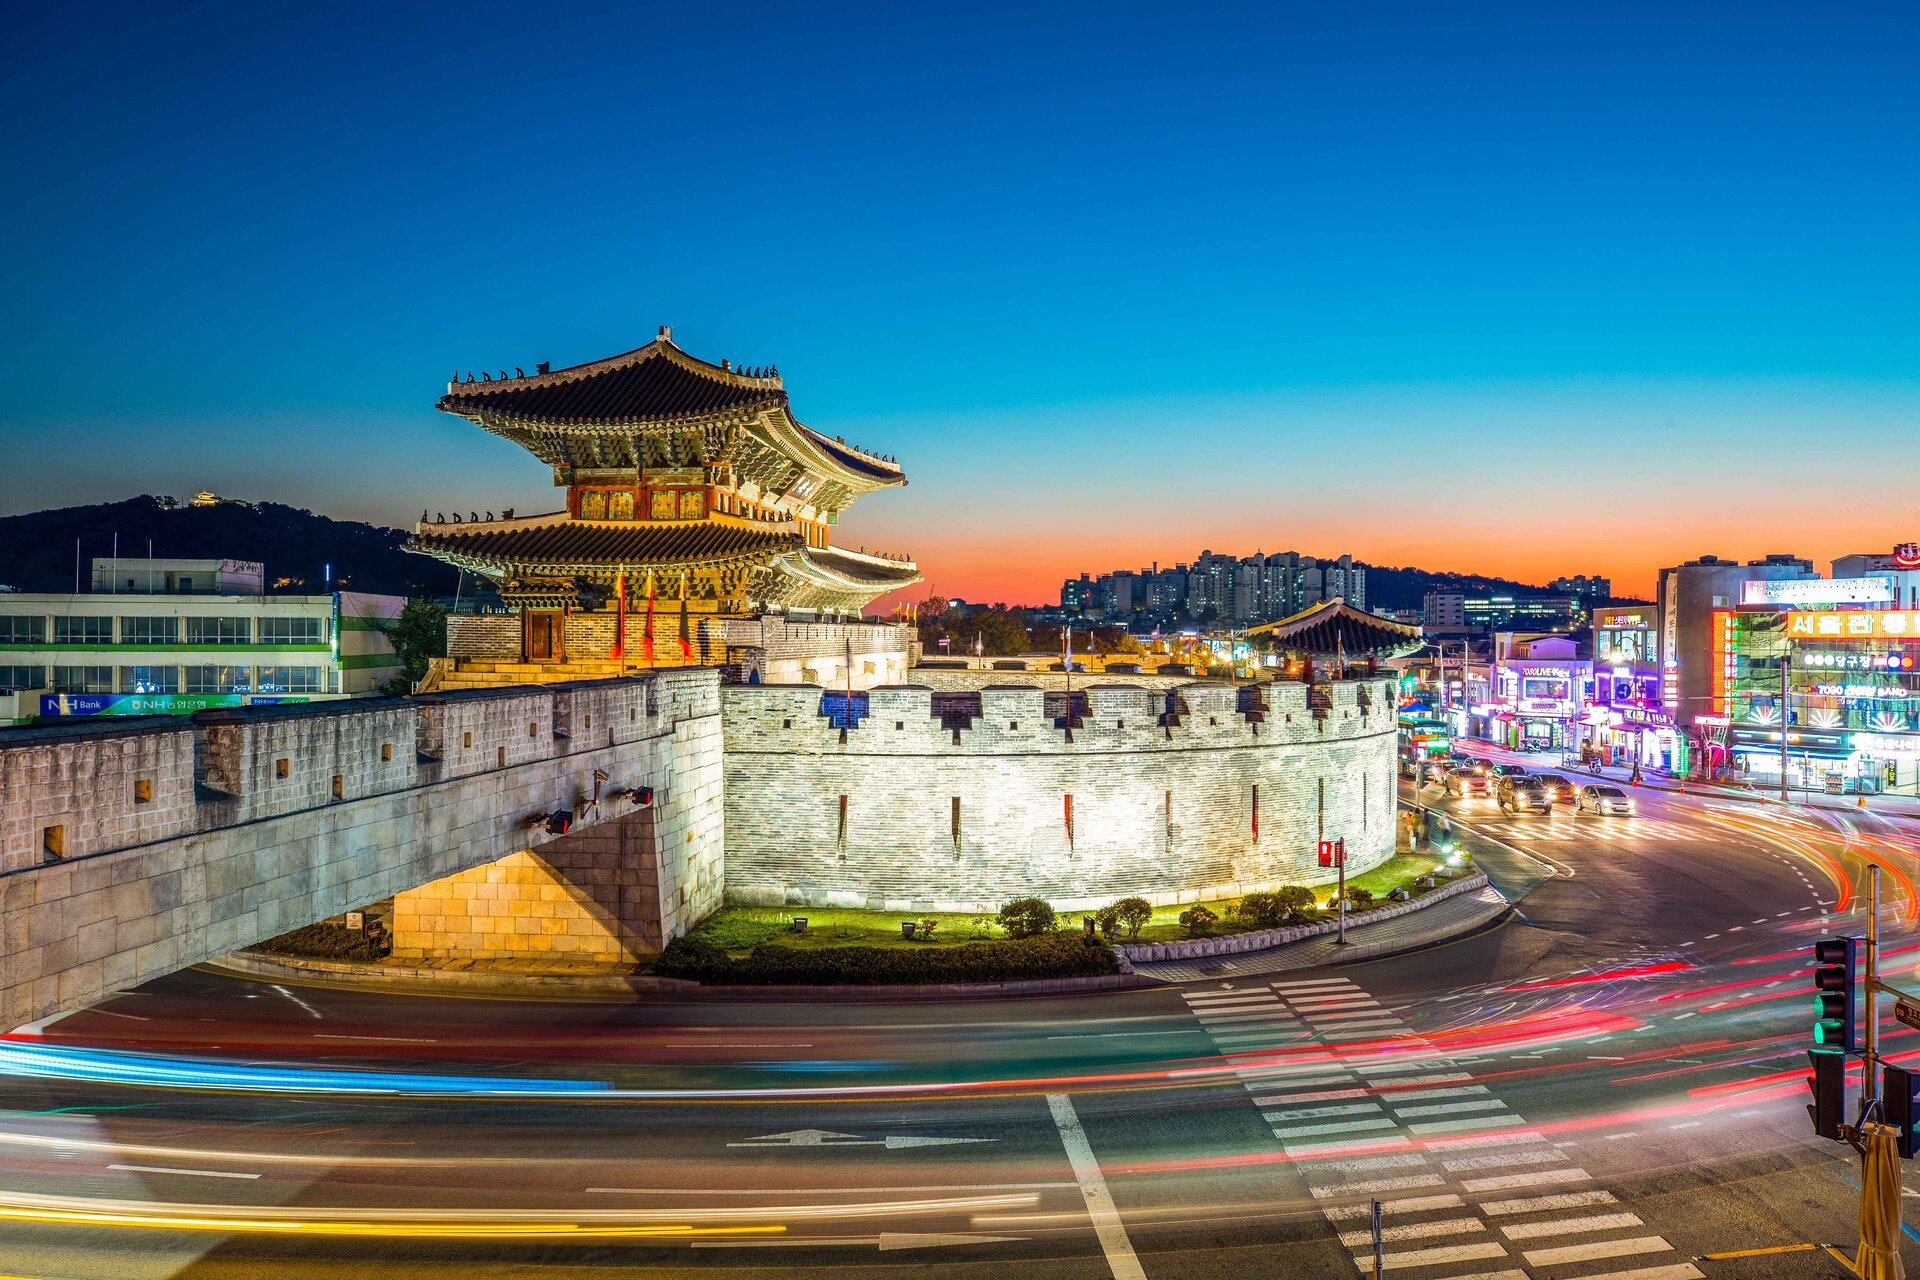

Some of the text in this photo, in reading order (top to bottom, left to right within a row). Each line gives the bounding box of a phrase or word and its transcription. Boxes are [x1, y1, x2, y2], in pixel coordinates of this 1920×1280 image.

[1835, 655, 1871, 668] 당구장
[1877, 687, 1907, 697] BAND
[80, 701, 101, 709] Bank
